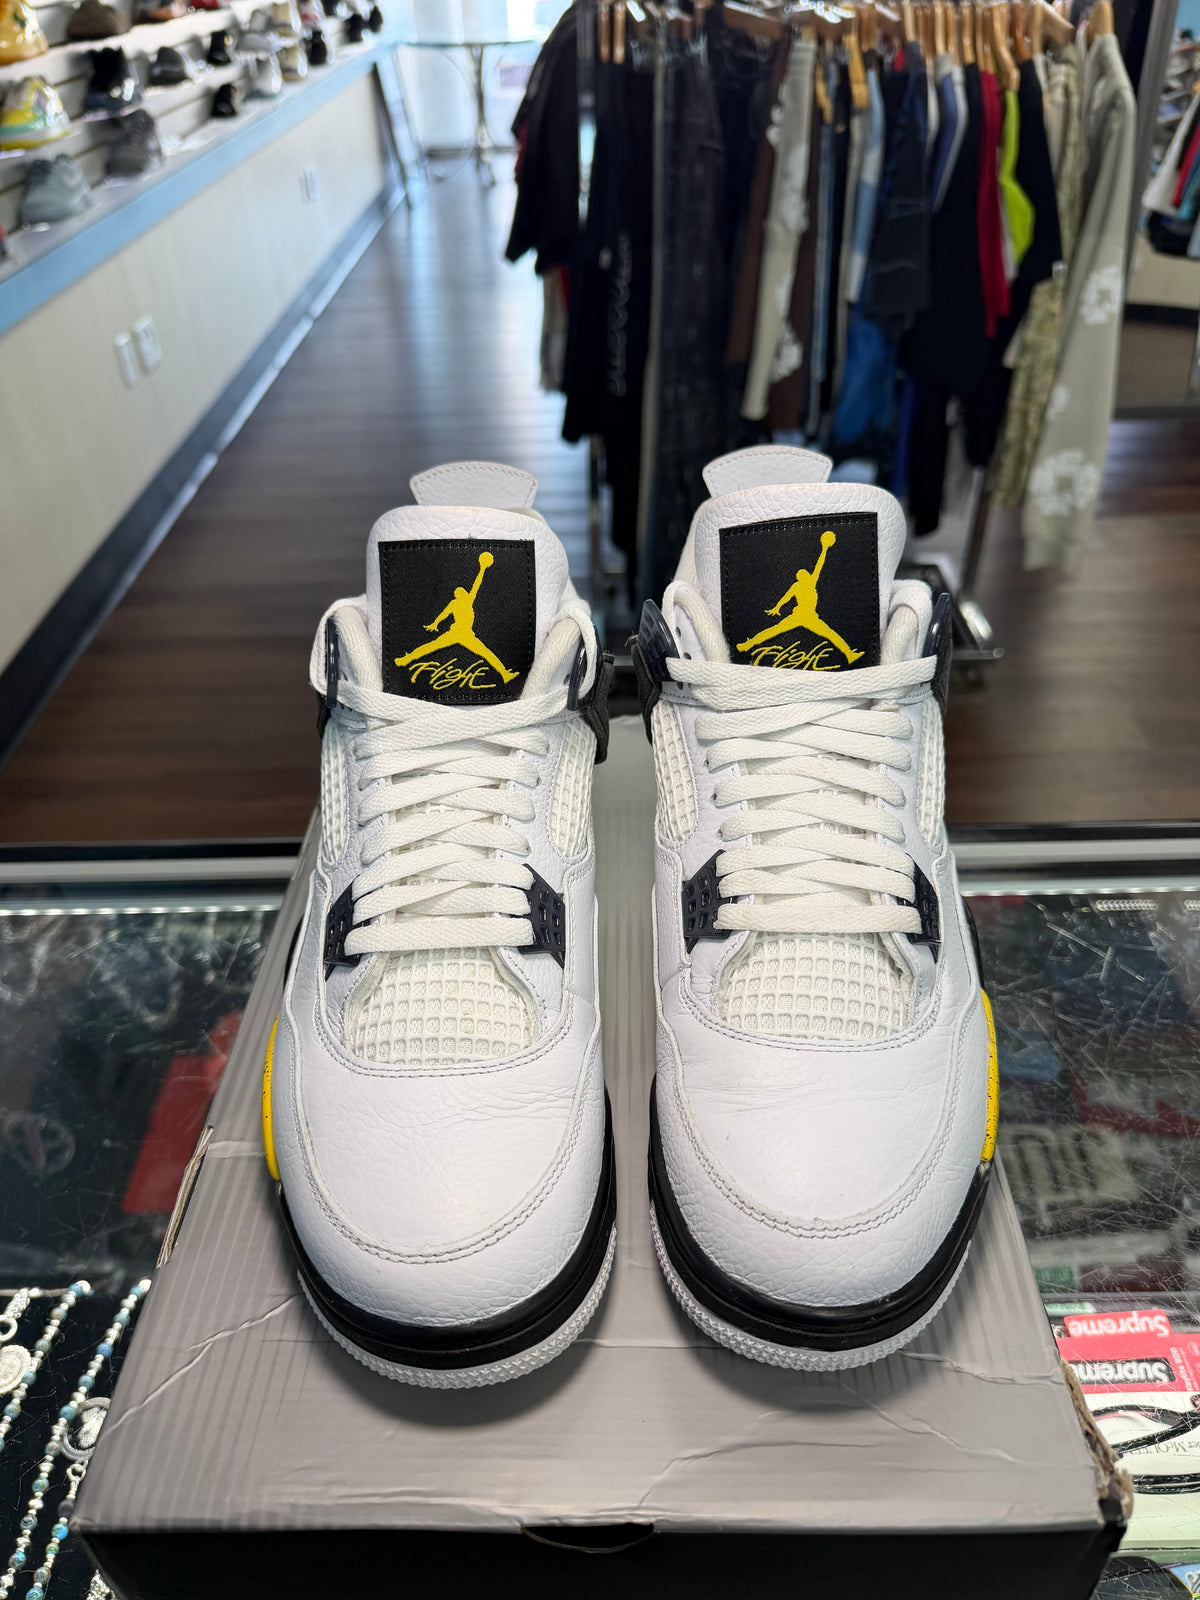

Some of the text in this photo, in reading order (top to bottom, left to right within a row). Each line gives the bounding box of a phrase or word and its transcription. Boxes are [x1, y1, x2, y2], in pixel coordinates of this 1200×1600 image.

[751, 640, 841, 670] Flight
[409, 658, 497, 690] Flight
[1068, 1310, 1170, 1337] Supreme
